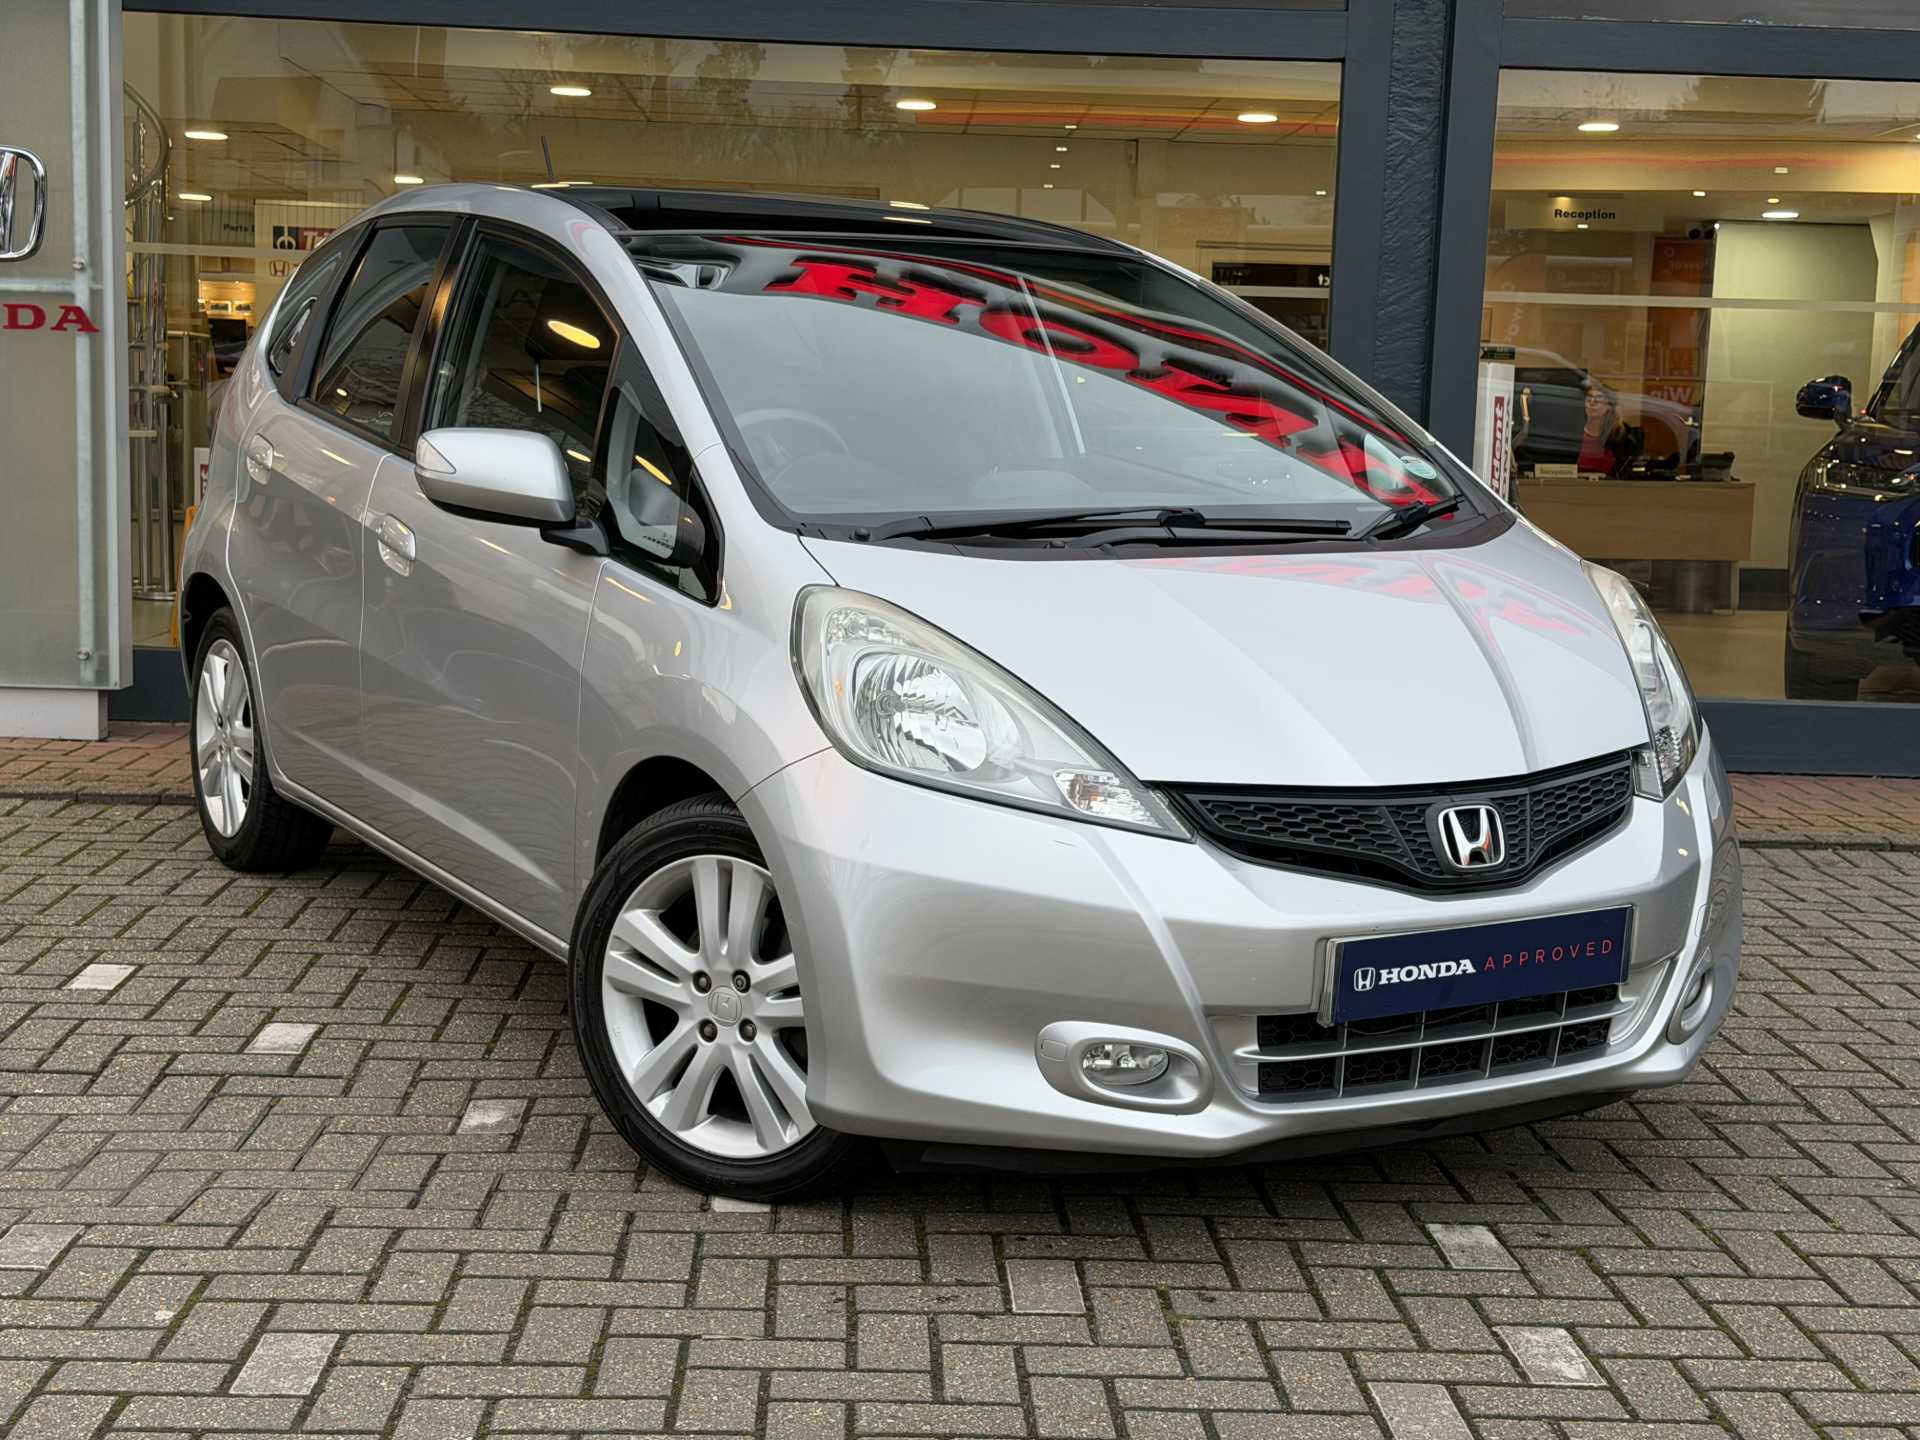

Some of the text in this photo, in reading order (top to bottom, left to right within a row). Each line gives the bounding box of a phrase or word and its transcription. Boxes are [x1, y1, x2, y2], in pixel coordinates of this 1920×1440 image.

[1554, 208, 1616, 220] Reception
[2, 303, 100, 333] DA
[1491, 402, 1504, 494] ident
[1379, 958, 1476, 985] HONDA
[1483, 938, 1613, 972] APPROVED
